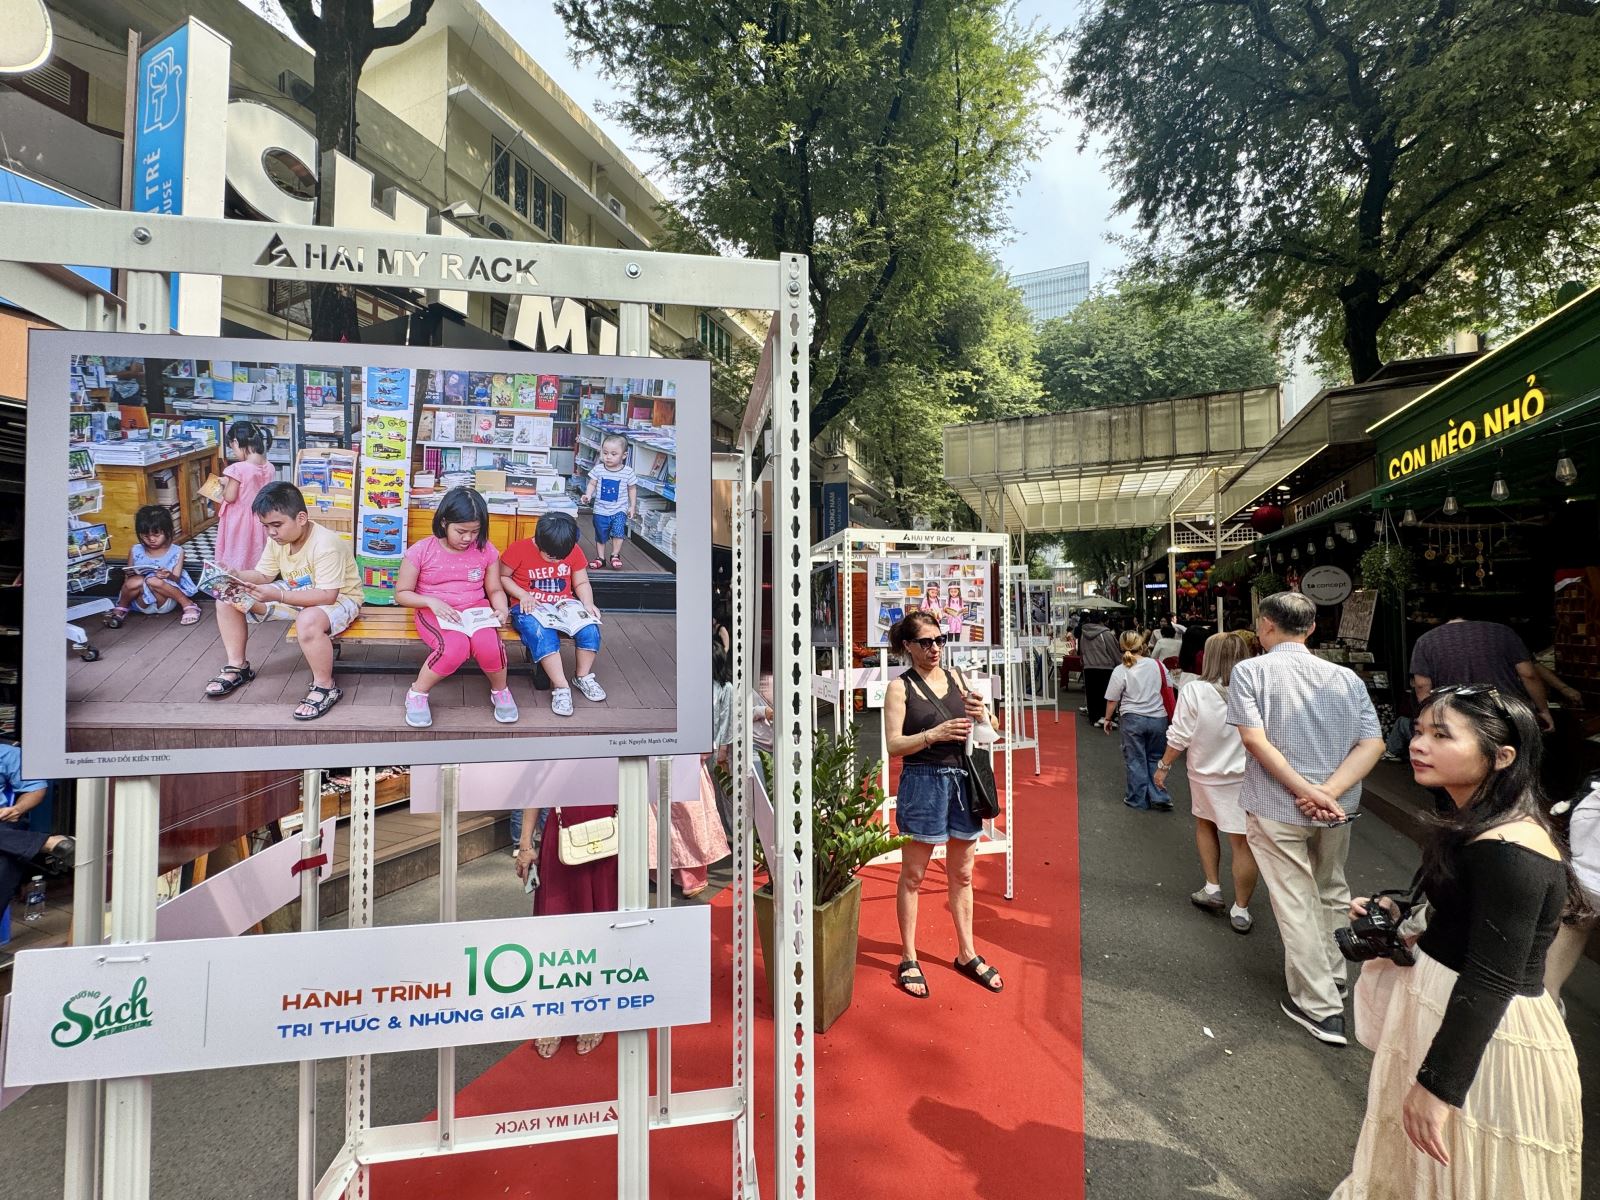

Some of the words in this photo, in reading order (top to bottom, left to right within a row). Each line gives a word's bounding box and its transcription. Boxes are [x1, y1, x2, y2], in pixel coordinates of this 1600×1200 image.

[304, 243, 364, 273] HAI
[377, 248, 429, 278] MY
[441, 253, 539, 287] RACK
[1388, 444, 1426, 481] CON
[1430, 418, 1476, 463] MÈO
[1483, 374, 1545, 438] NHỎ
[1316, 581, 1346, 589] concept
[98, 756, 117, 764] TRAO
[464, 943, 534, 996] 10
[538, 971, 592, 990] LAN
[50, 976, 153, 1048] Sách
[277, 1023, 312, 1039] TRI
[387, 1016, 402, 1029] &
